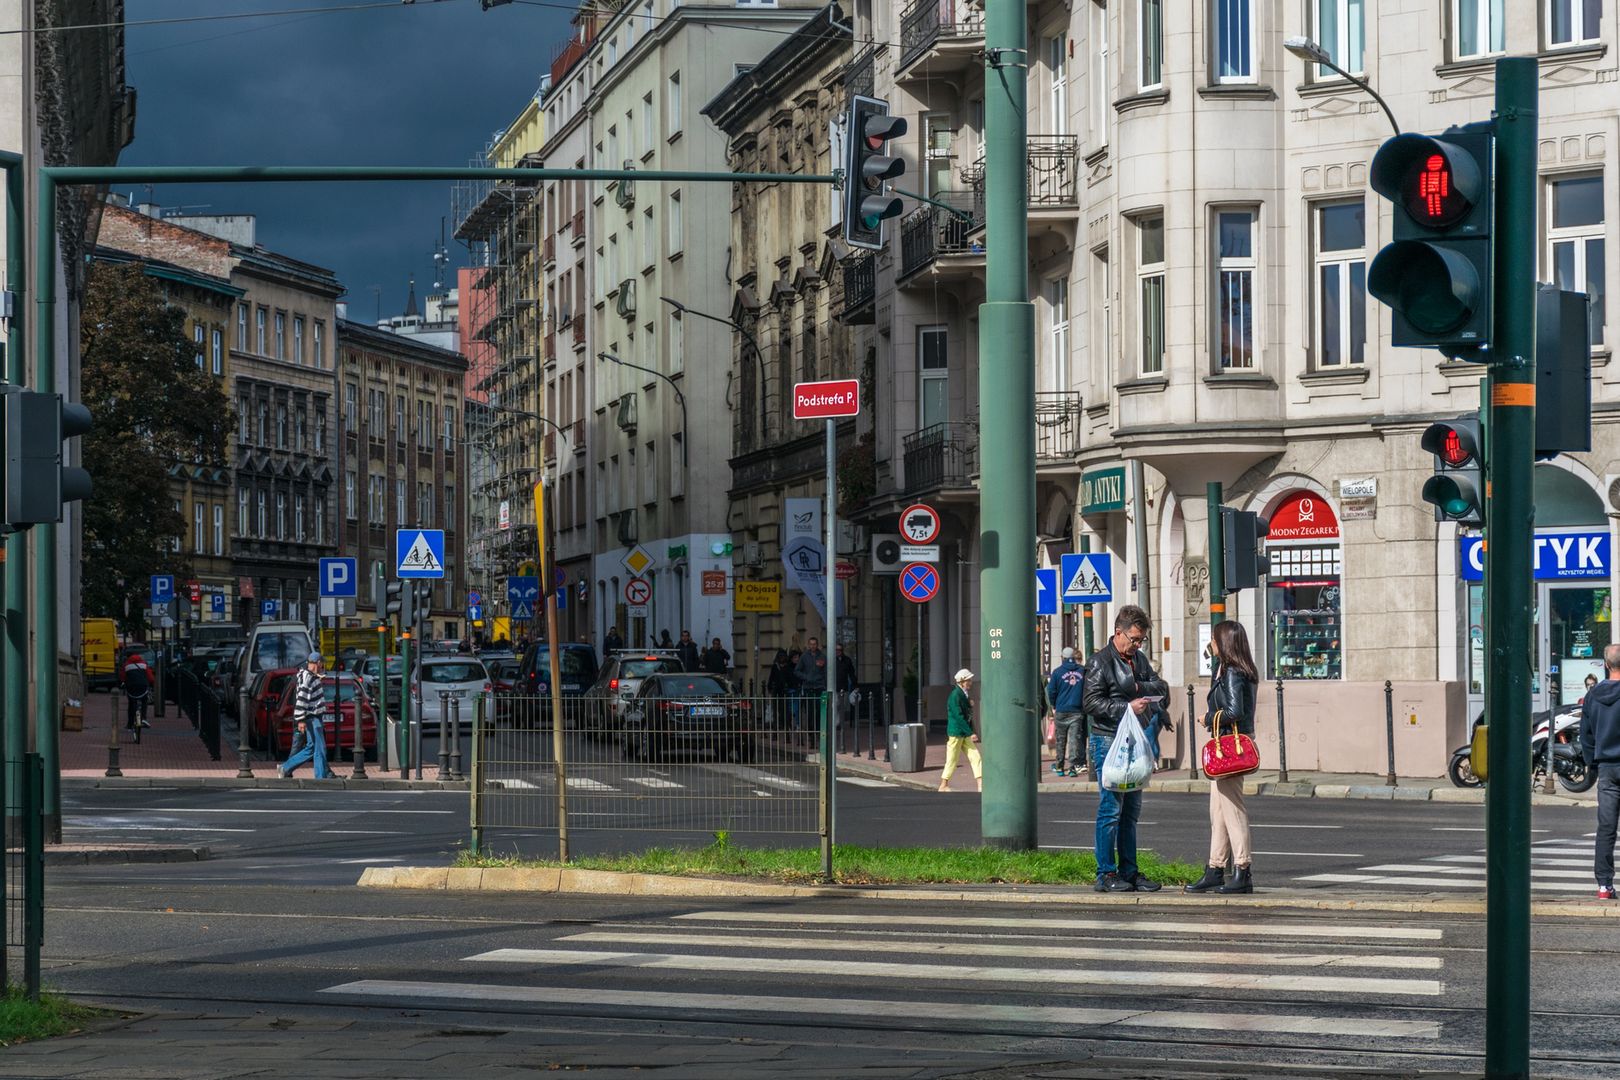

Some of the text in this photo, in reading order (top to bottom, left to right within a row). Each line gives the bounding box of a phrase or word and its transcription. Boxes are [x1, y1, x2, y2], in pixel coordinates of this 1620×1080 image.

[798, 393, 844, 407] Podstrefa
[1093, 475, 1120, 504] ANTYKI
[1343, 486, 1373, 494] WIELOPOLE
[911, 529, 928, 539] 7,5t
[1469, 537, 1604, 572] OTYK
[328, 562, 348, 592] P
[156, 578, 168, 595] P
[746, 584, 777, 594] Objazd
[214, 596, 222, 606] P
[264, 602, 273, 613] P
[990, 628, 1003, 637] GR
[991, 640, 1000, 648] 01
[992, 651, 1002, 659] 08
